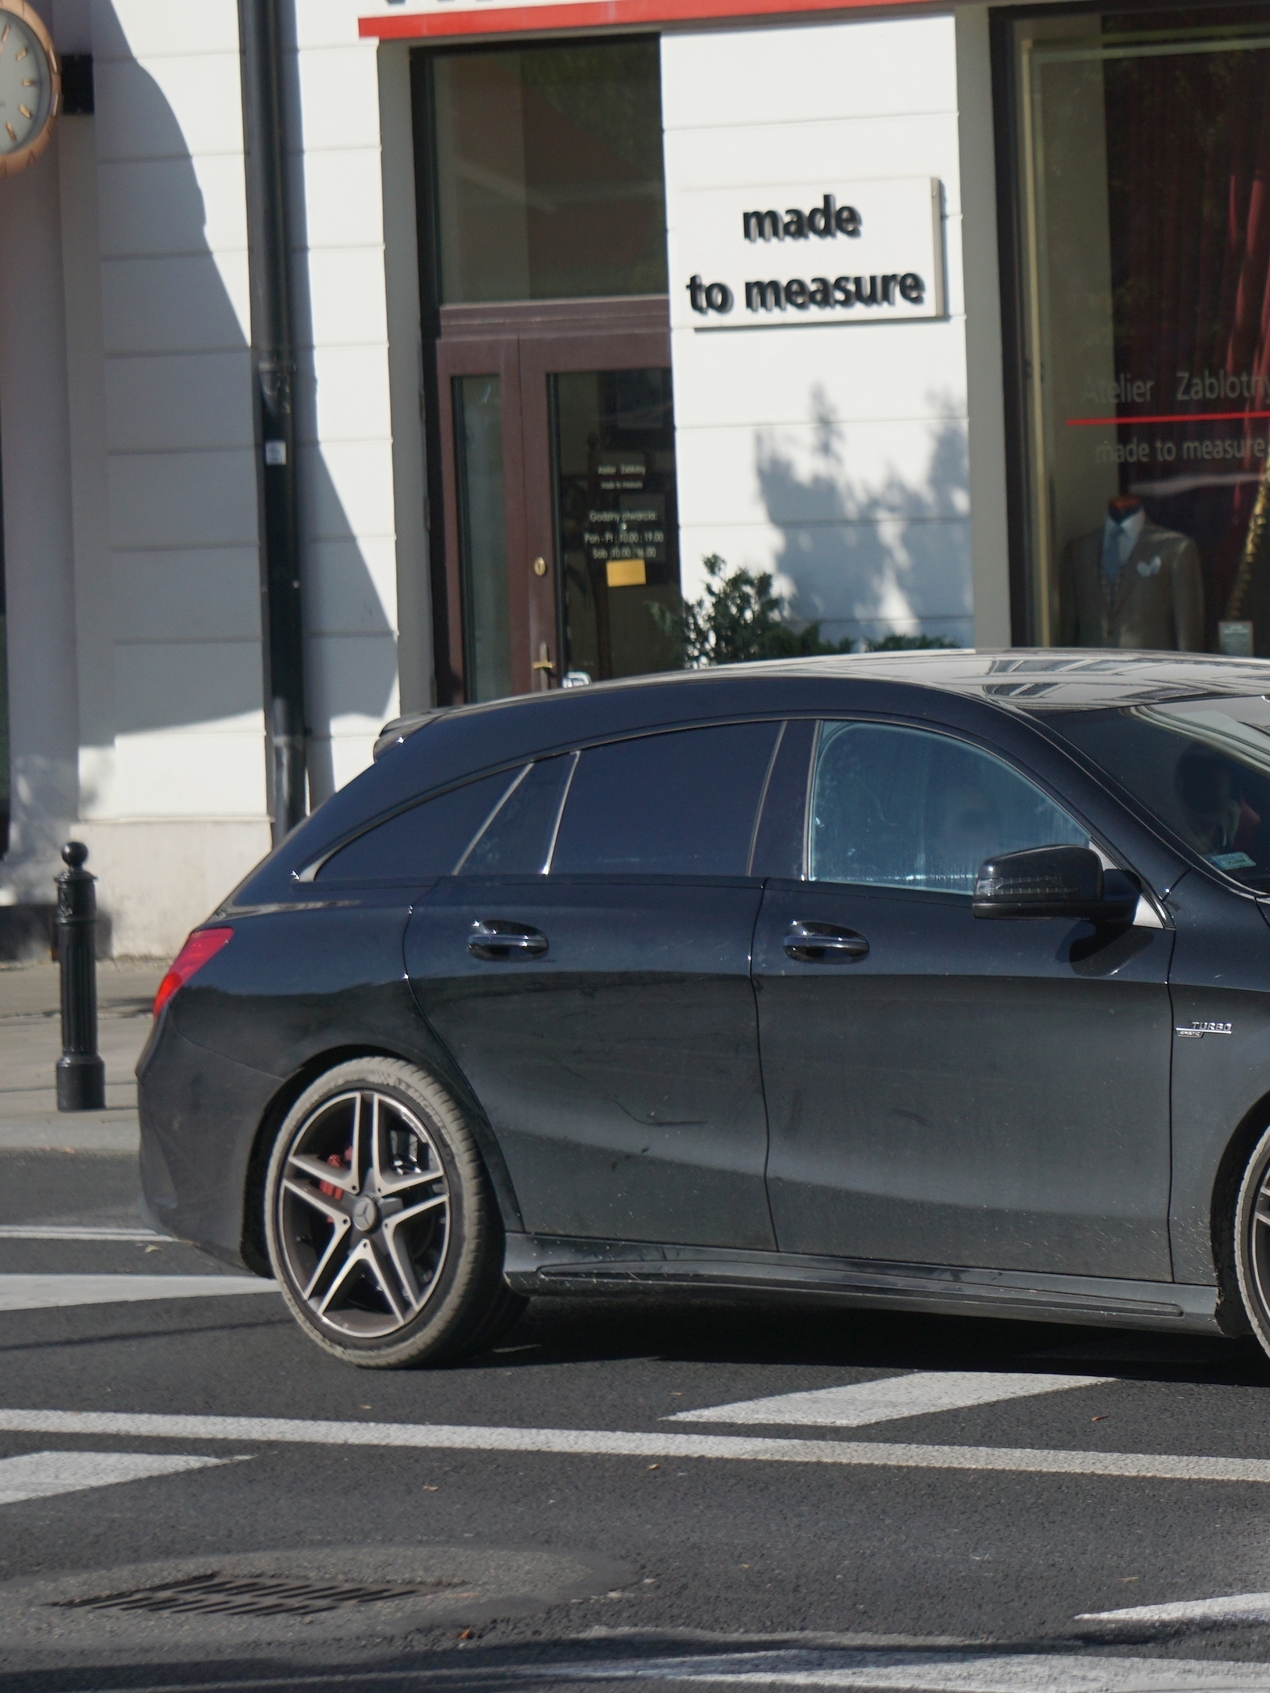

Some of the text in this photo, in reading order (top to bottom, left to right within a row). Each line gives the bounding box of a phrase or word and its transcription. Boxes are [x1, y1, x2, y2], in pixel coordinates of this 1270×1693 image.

[743, 194, 862, 242] made
[686, 272, 926, 315] to measure
[1083, 372, 1155, 403] Atelier
[1095, 437, 1266, 464] made to measure
[1191, 1021, 1232, 1031] TURBO
